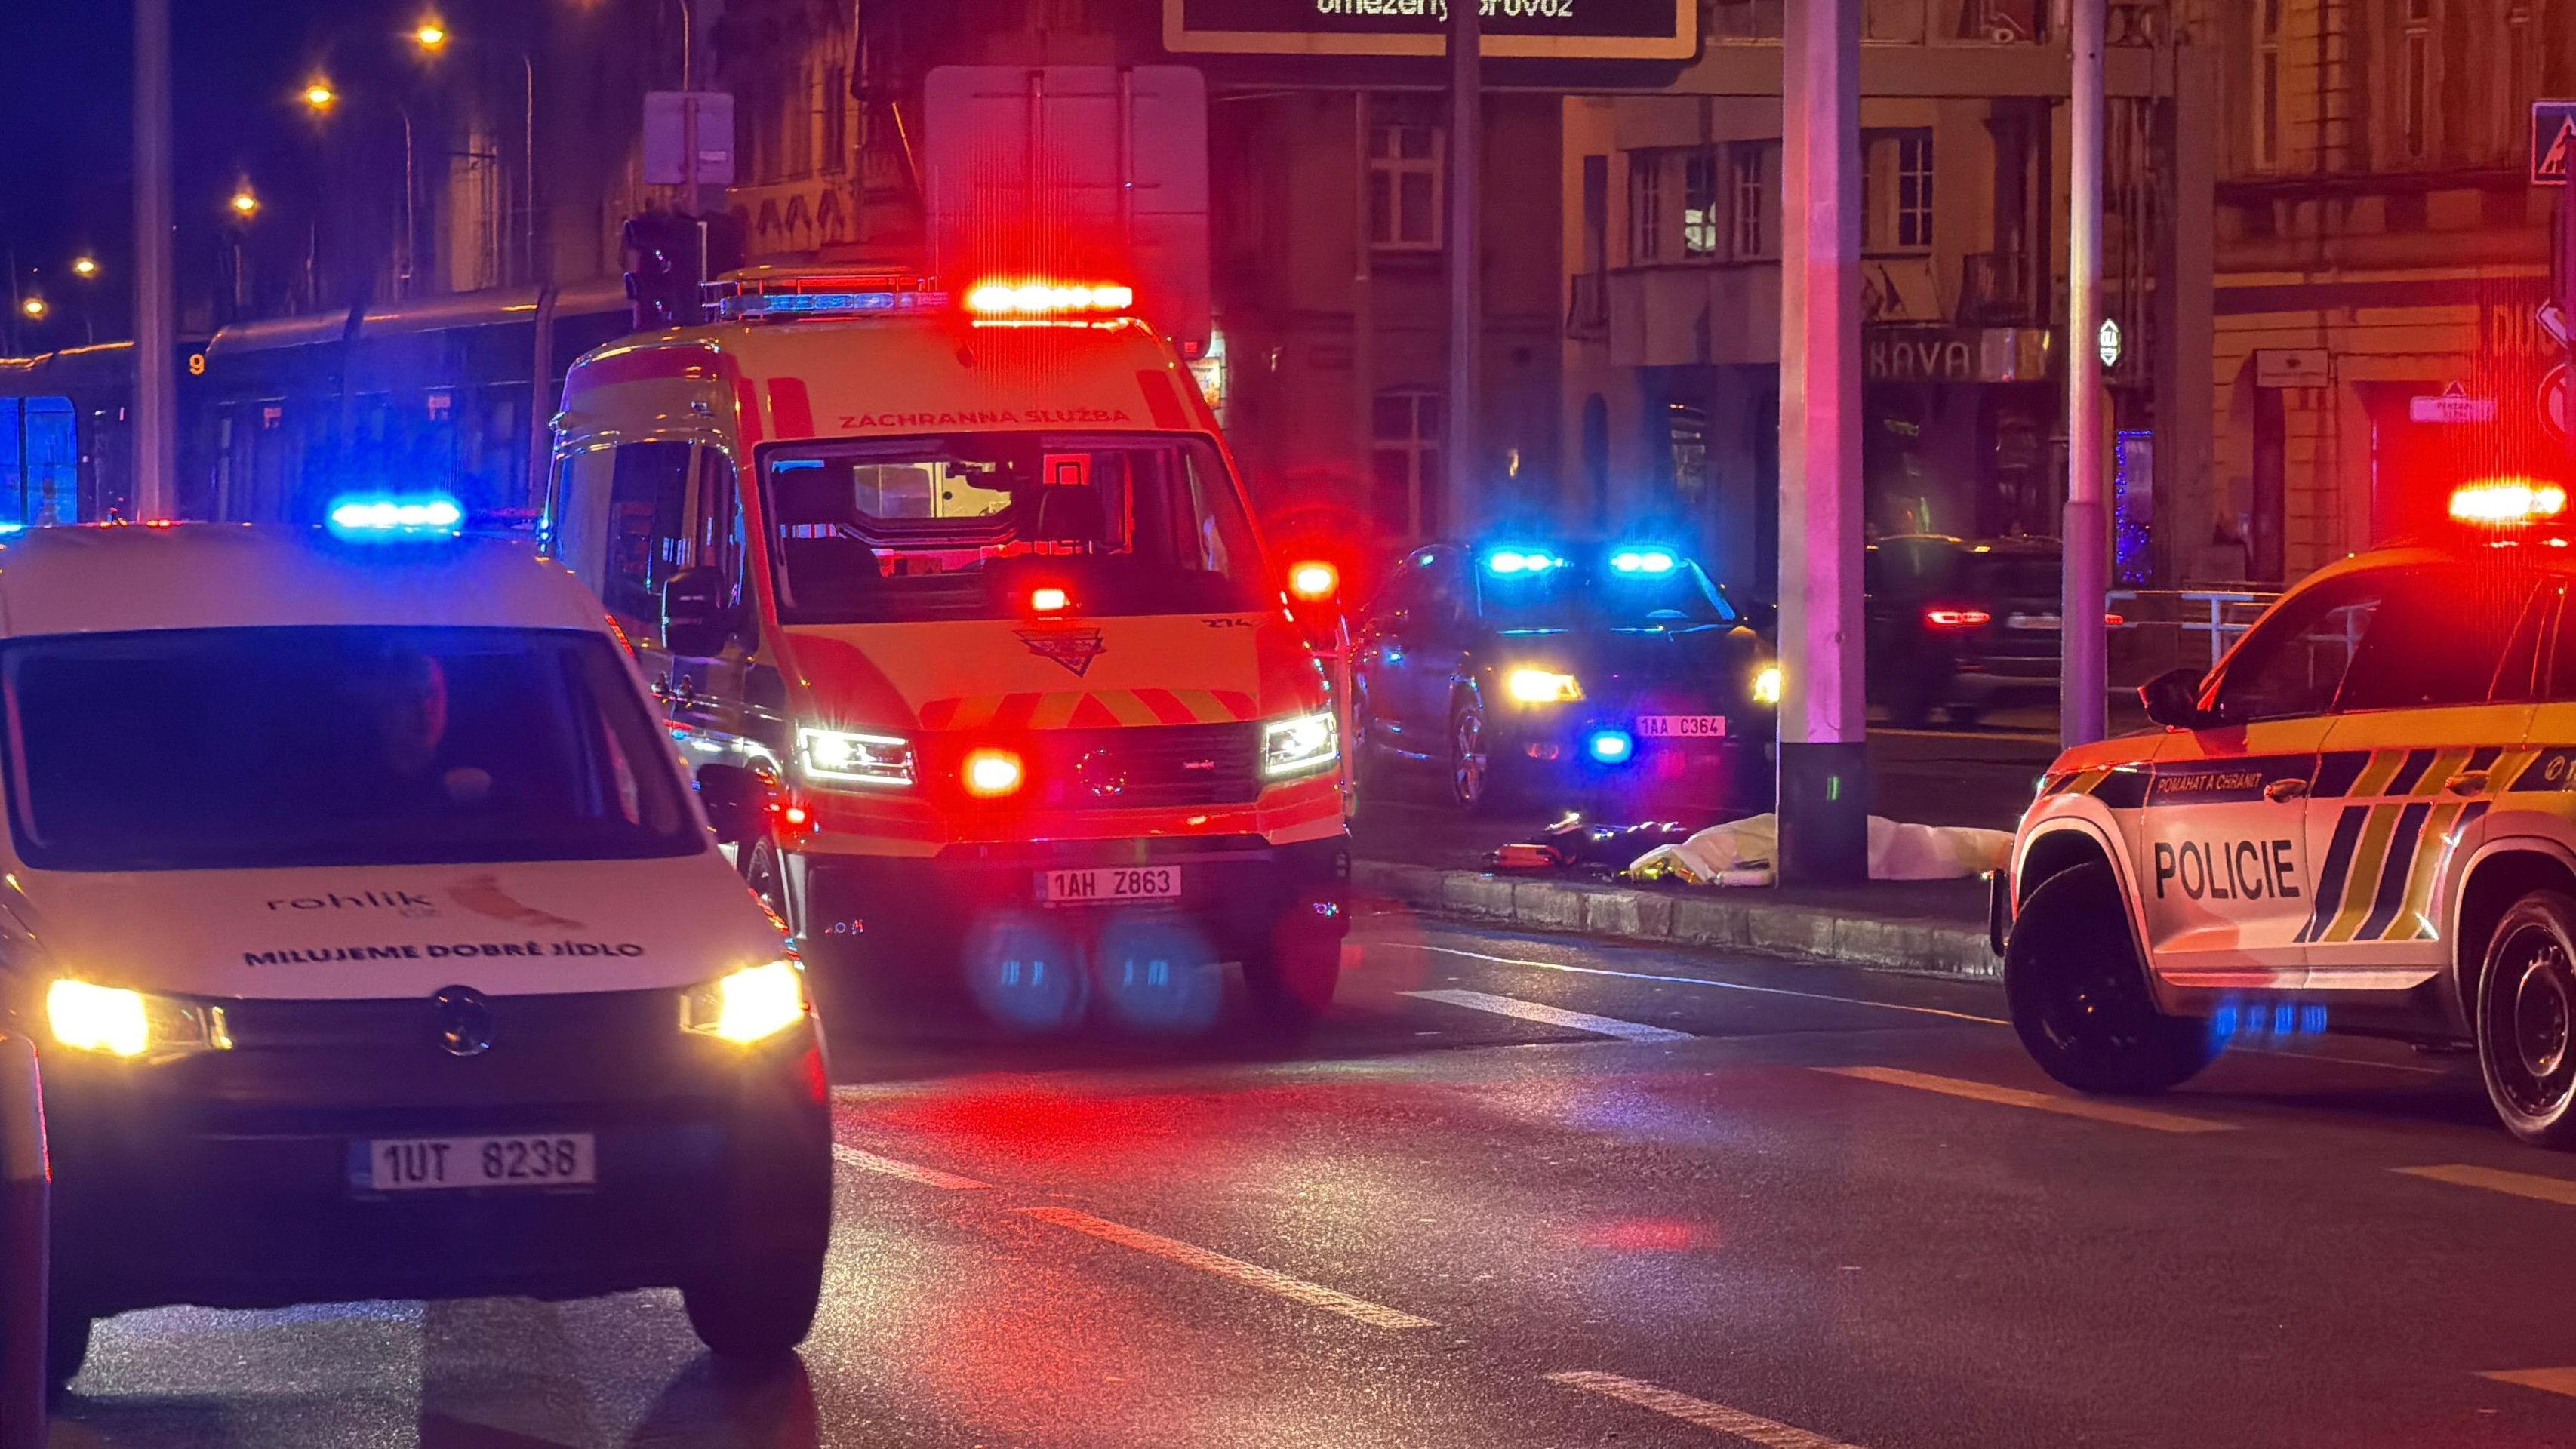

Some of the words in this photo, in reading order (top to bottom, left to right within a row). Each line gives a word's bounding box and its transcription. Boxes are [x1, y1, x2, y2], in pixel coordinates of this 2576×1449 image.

[189, 353, 205, 375] 9
[1641, 718, 1669, 734] 1AA
[1680, 718, 1718, 734] C364
[2154, 839, 2301, 900] POLICIE
[1054, 872, 1095, 897] 1AH
[1113, 869, 1170, 894] Z863
[266, 891, 432, 911] rohlik
[242, 944, 420, 967] MILUJEME
[383, 1143, 451, 1183] 1UT
[482, 1138, 576, 1179] 8238
